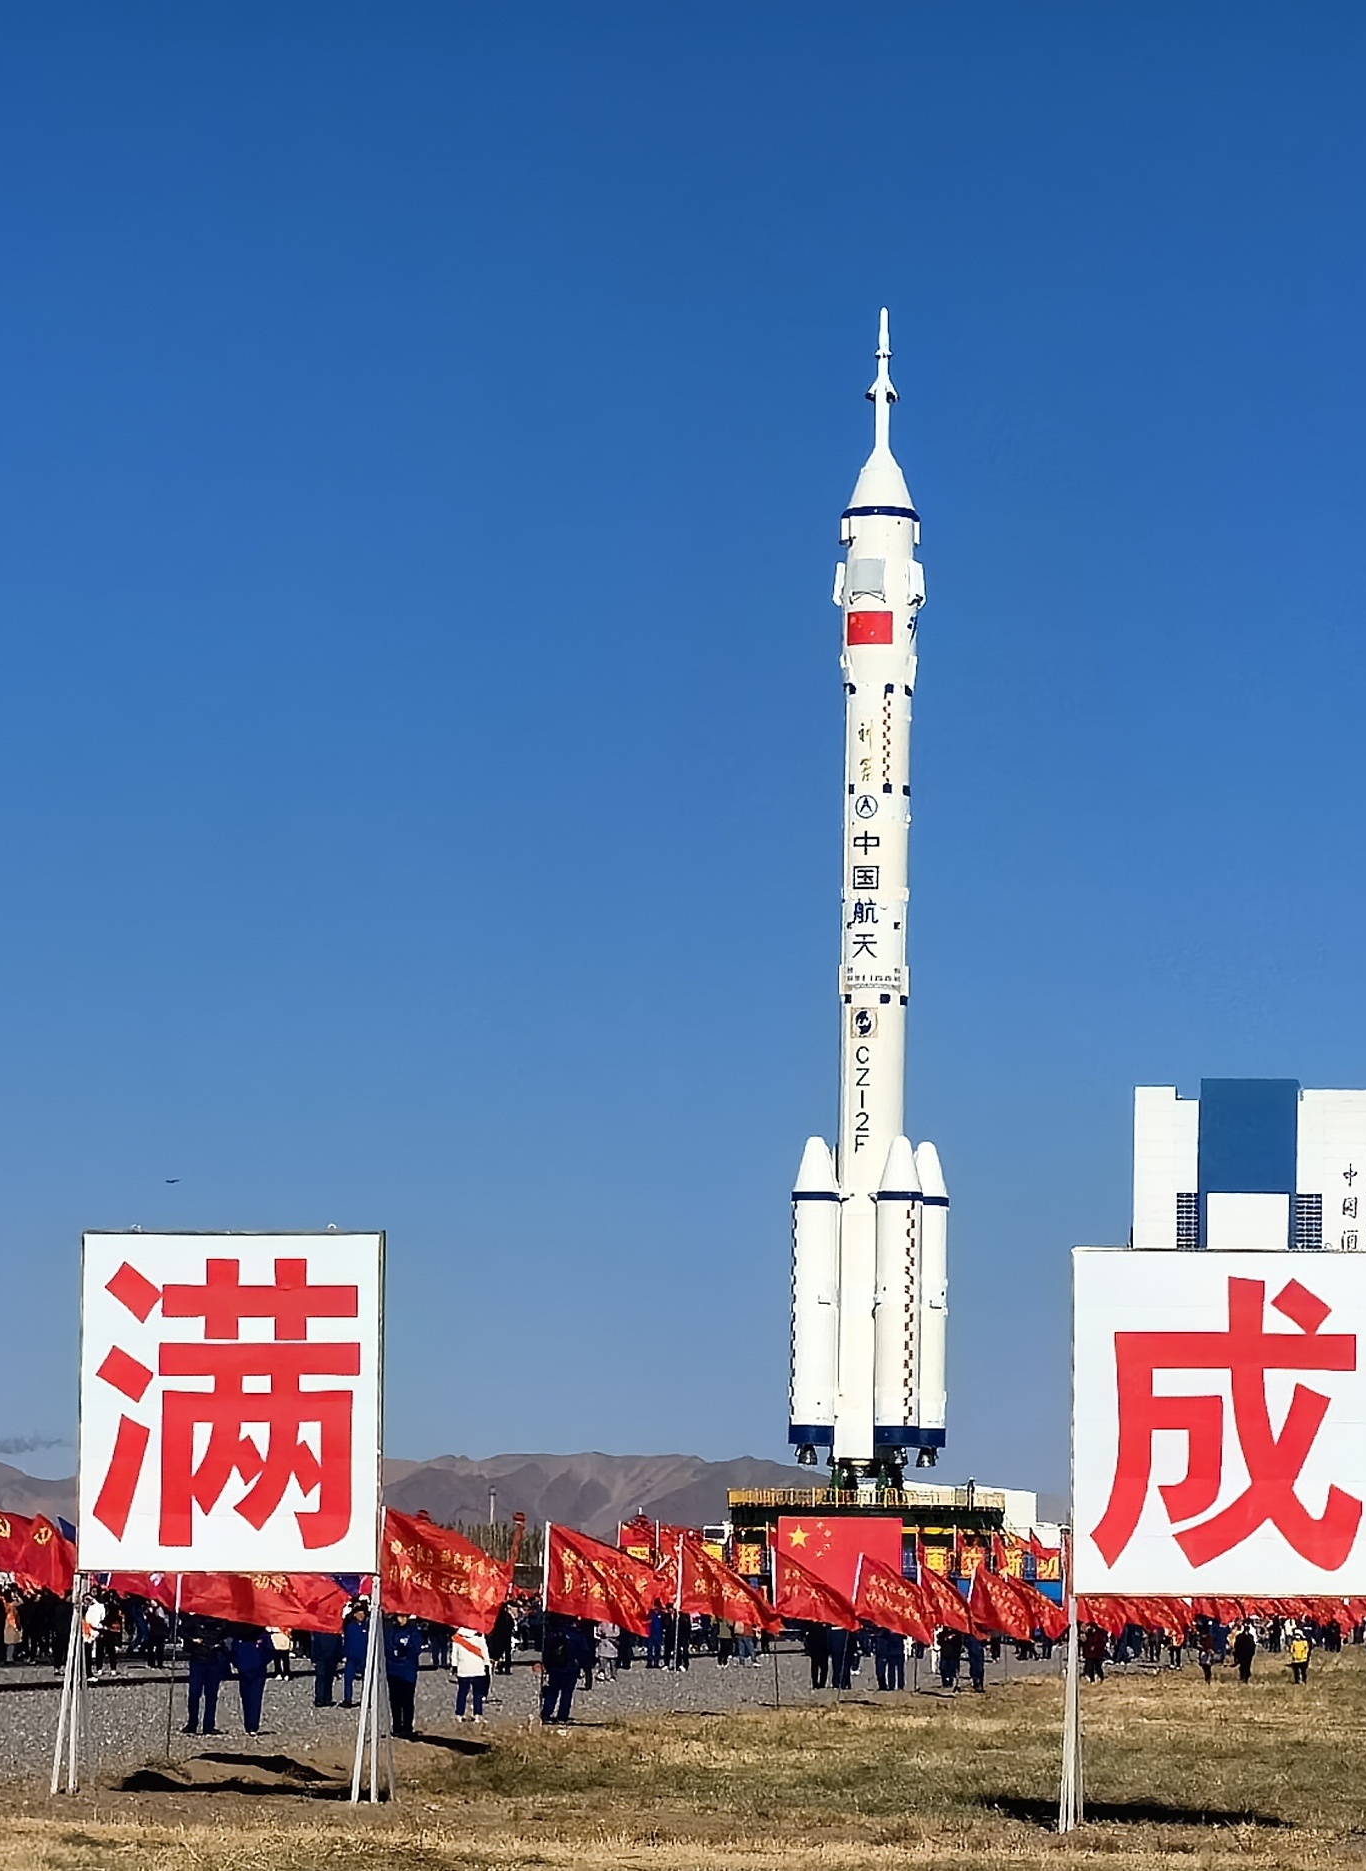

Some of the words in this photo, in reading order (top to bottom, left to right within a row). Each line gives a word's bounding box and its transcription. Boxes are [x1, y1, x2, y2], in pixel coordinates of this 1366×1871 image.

[852, 830, 880, 959] 中国航天
[93, 1258, 360, 1549] 满
[1091, 1277, 1362, 1572] 成
